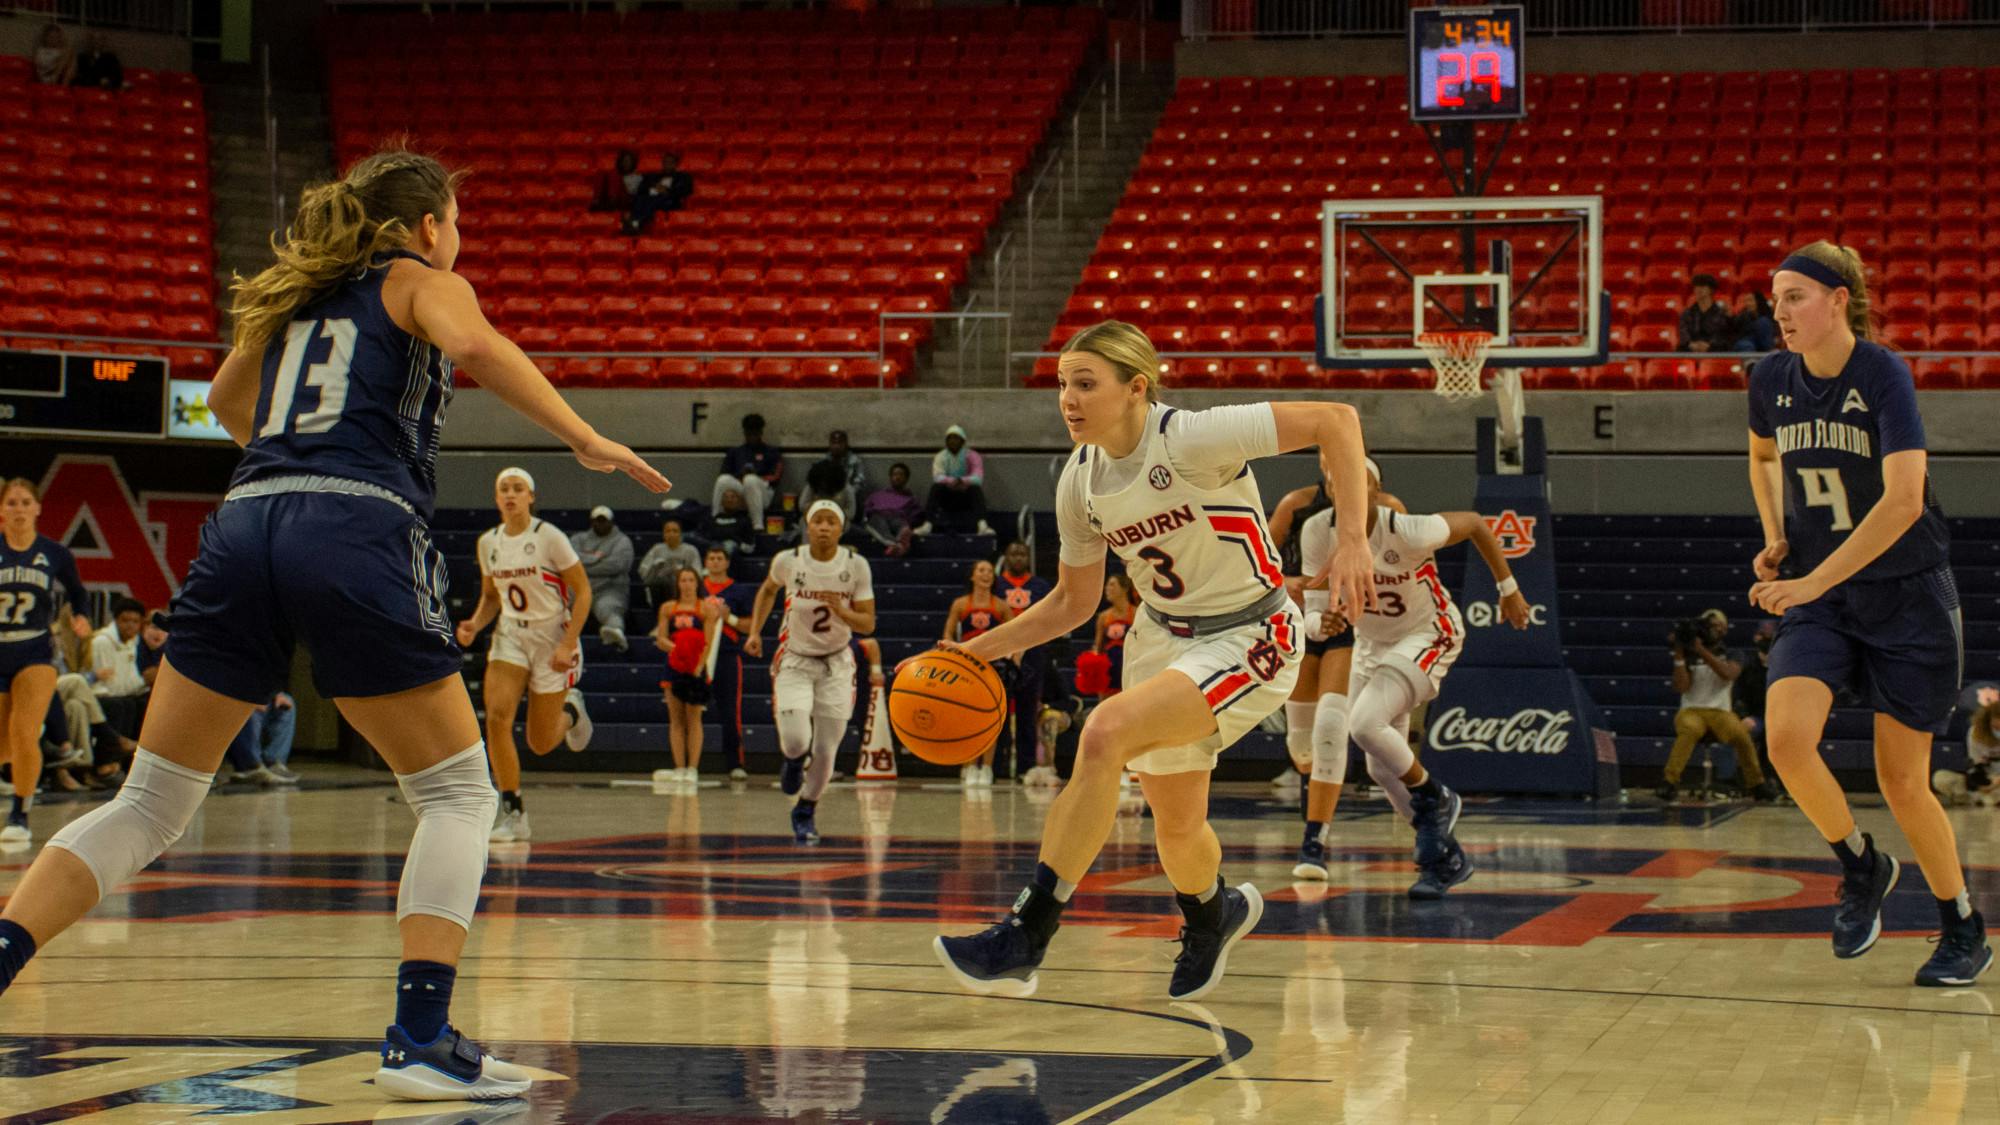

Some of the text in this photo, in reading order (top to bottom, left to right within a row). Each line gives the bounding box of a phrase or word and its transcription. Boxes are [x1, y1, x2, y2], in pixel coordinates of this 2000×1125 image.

[1444, 19, 1511, 47] 4:34
[1436, 52, 1502, 106] 29
[93, 360, 136, 381] UNF
[259, 317, 358, 438] 13
[692, 402, 708, 434] F
[1595, 405, 1613, 439] E
[1815, 418, 1872, 458] FLORIDA
[1797, 468, 1853, 531] 4
[1138, 546, 1185, 600] 3
[1373, 571, 1410, 586] URN
[508, 584, 527, 612] 0
[812, 605, 831, 633] 2
